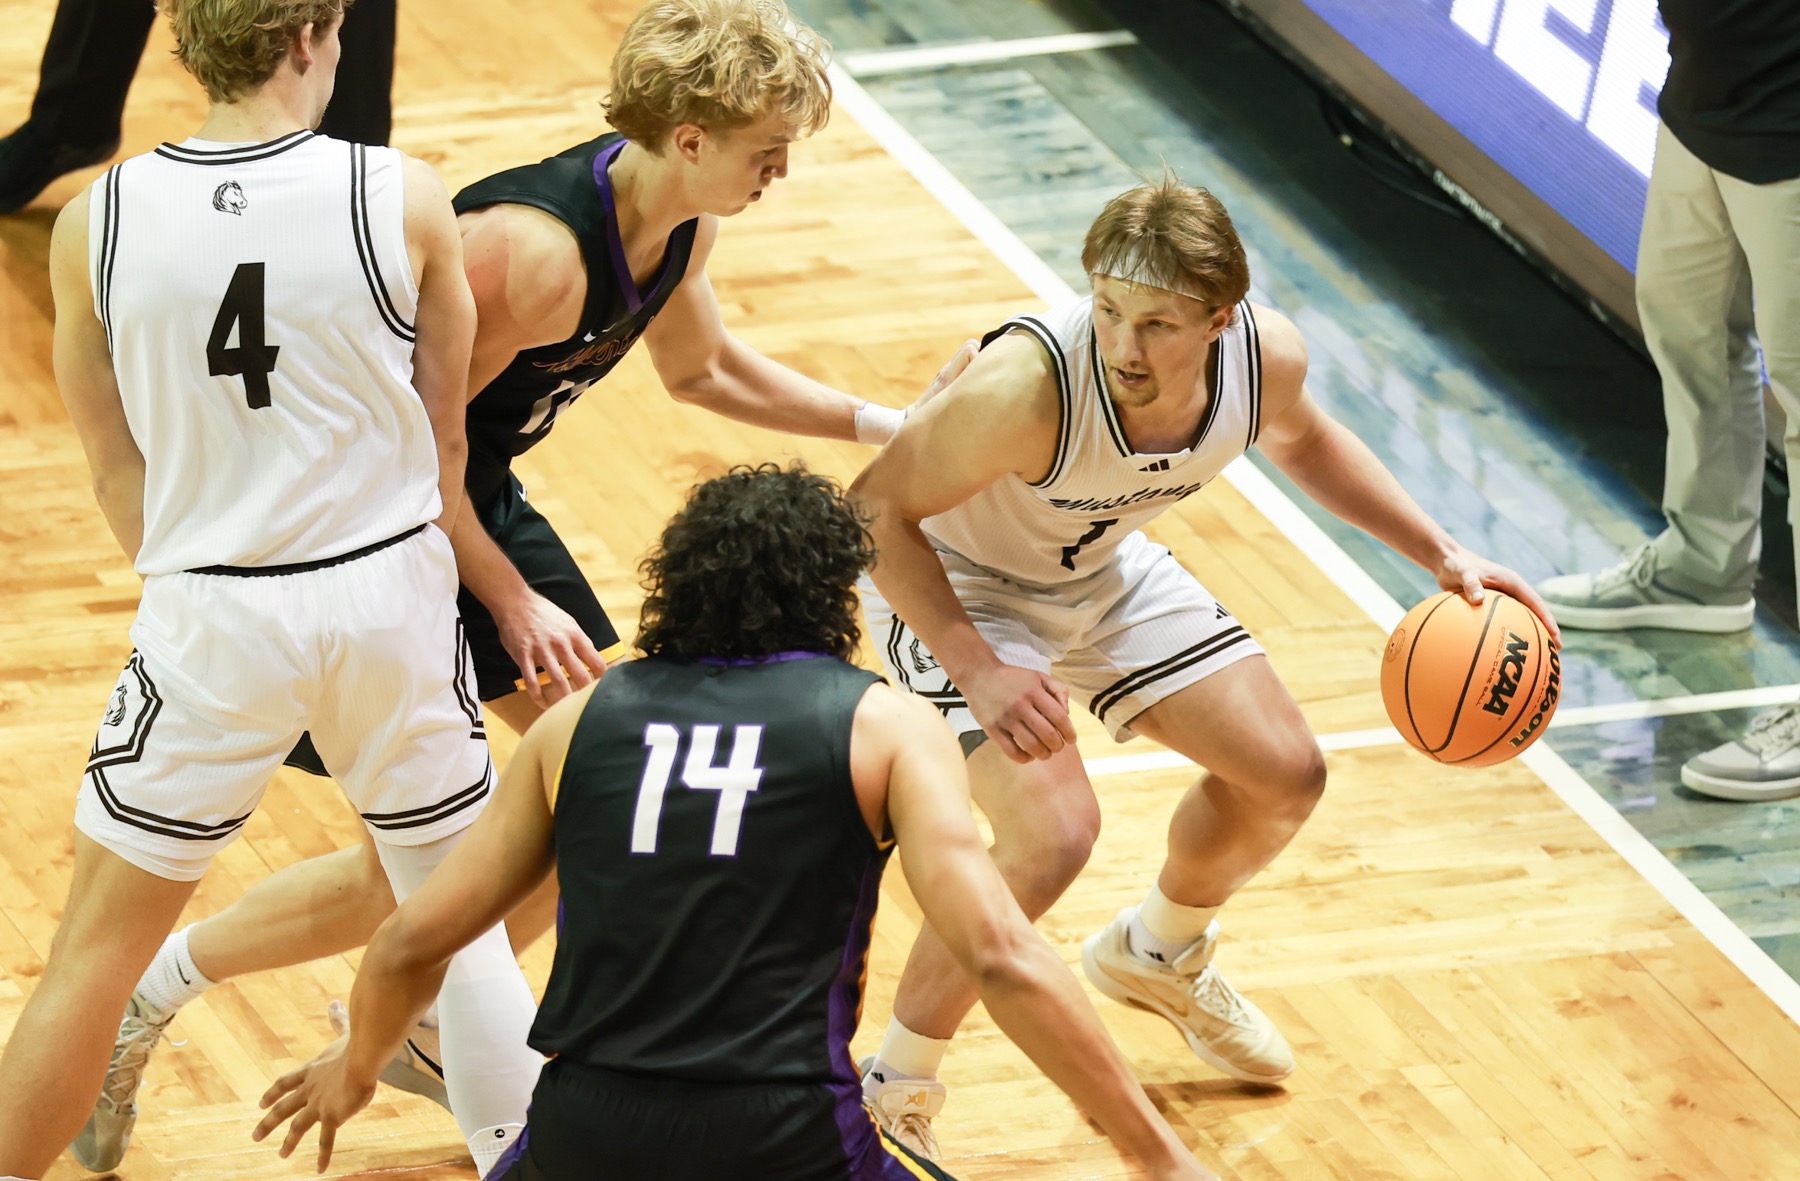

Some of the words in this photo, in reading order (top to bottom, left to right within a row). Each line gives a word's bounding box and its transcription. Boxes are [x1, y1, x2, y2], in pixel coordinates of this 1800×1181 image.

[206, 262, 281, 410] 4
[1482, 631, 1529, 716] NCAA
[629, 722, 766, 857] 14
